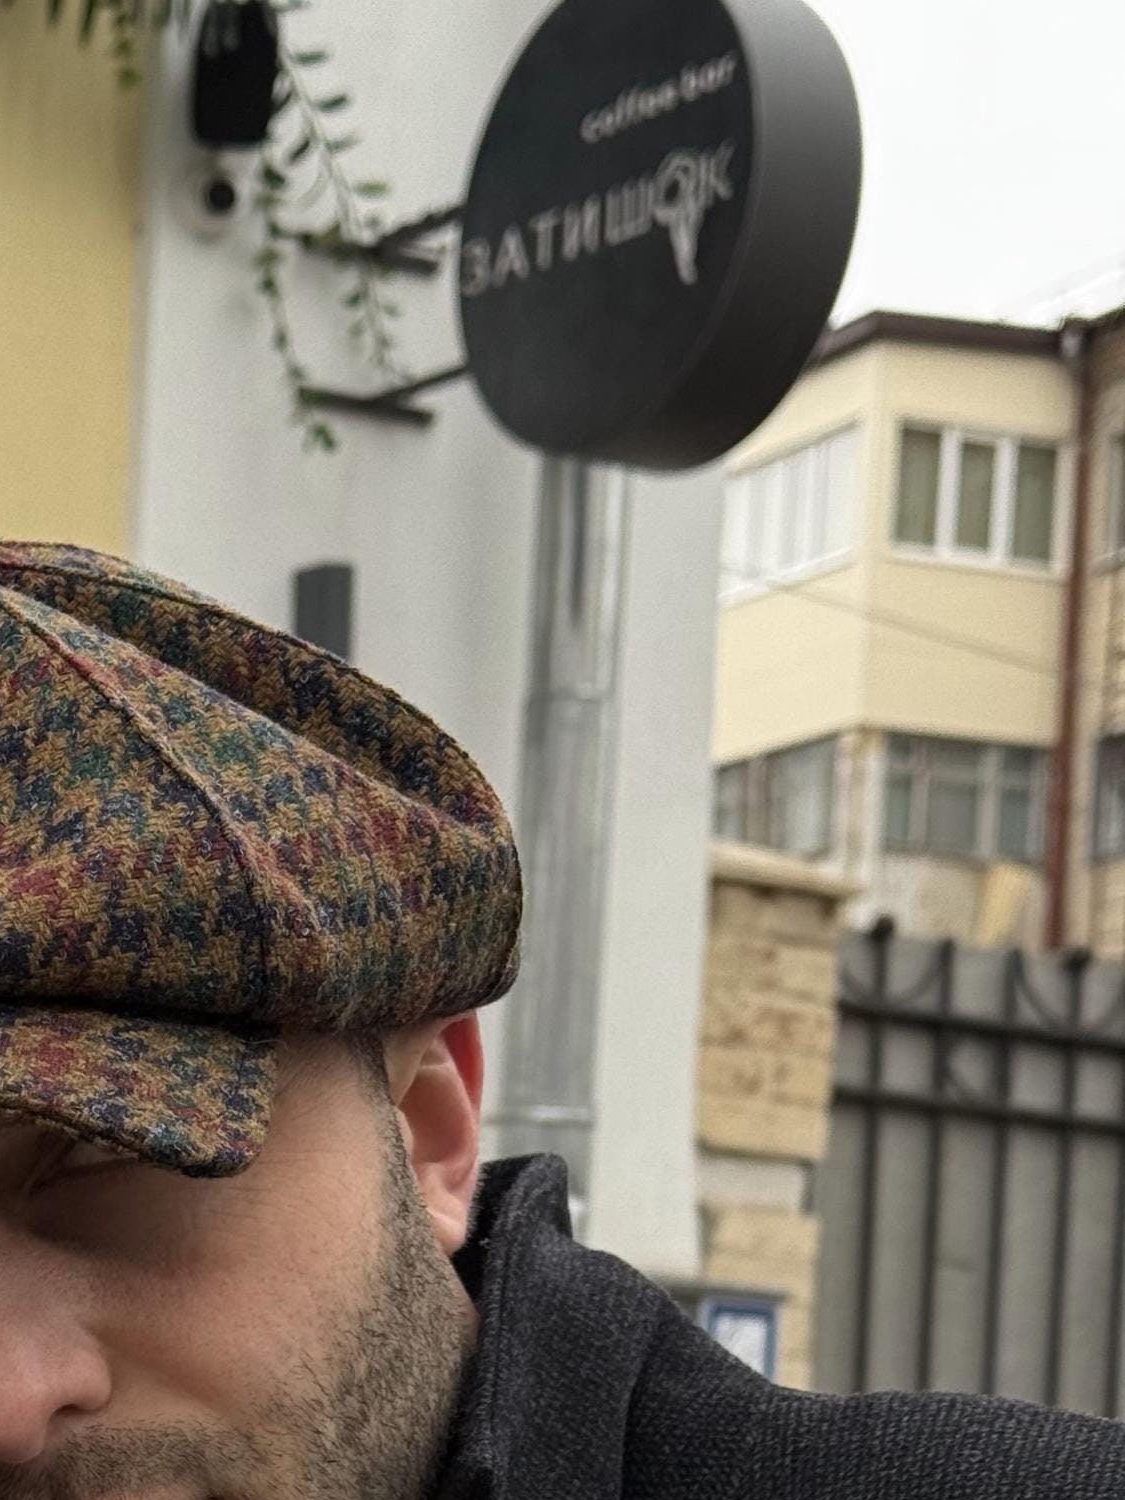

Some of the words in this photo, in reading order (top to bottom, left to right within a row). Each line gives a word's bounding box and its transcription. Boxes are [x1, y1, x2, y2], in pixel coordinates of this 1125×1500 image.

[580, 79, 677, 143] coffee
[678, 52, 737, 102] bar
[461, 140, 735, 296] ЗАТИШОК
